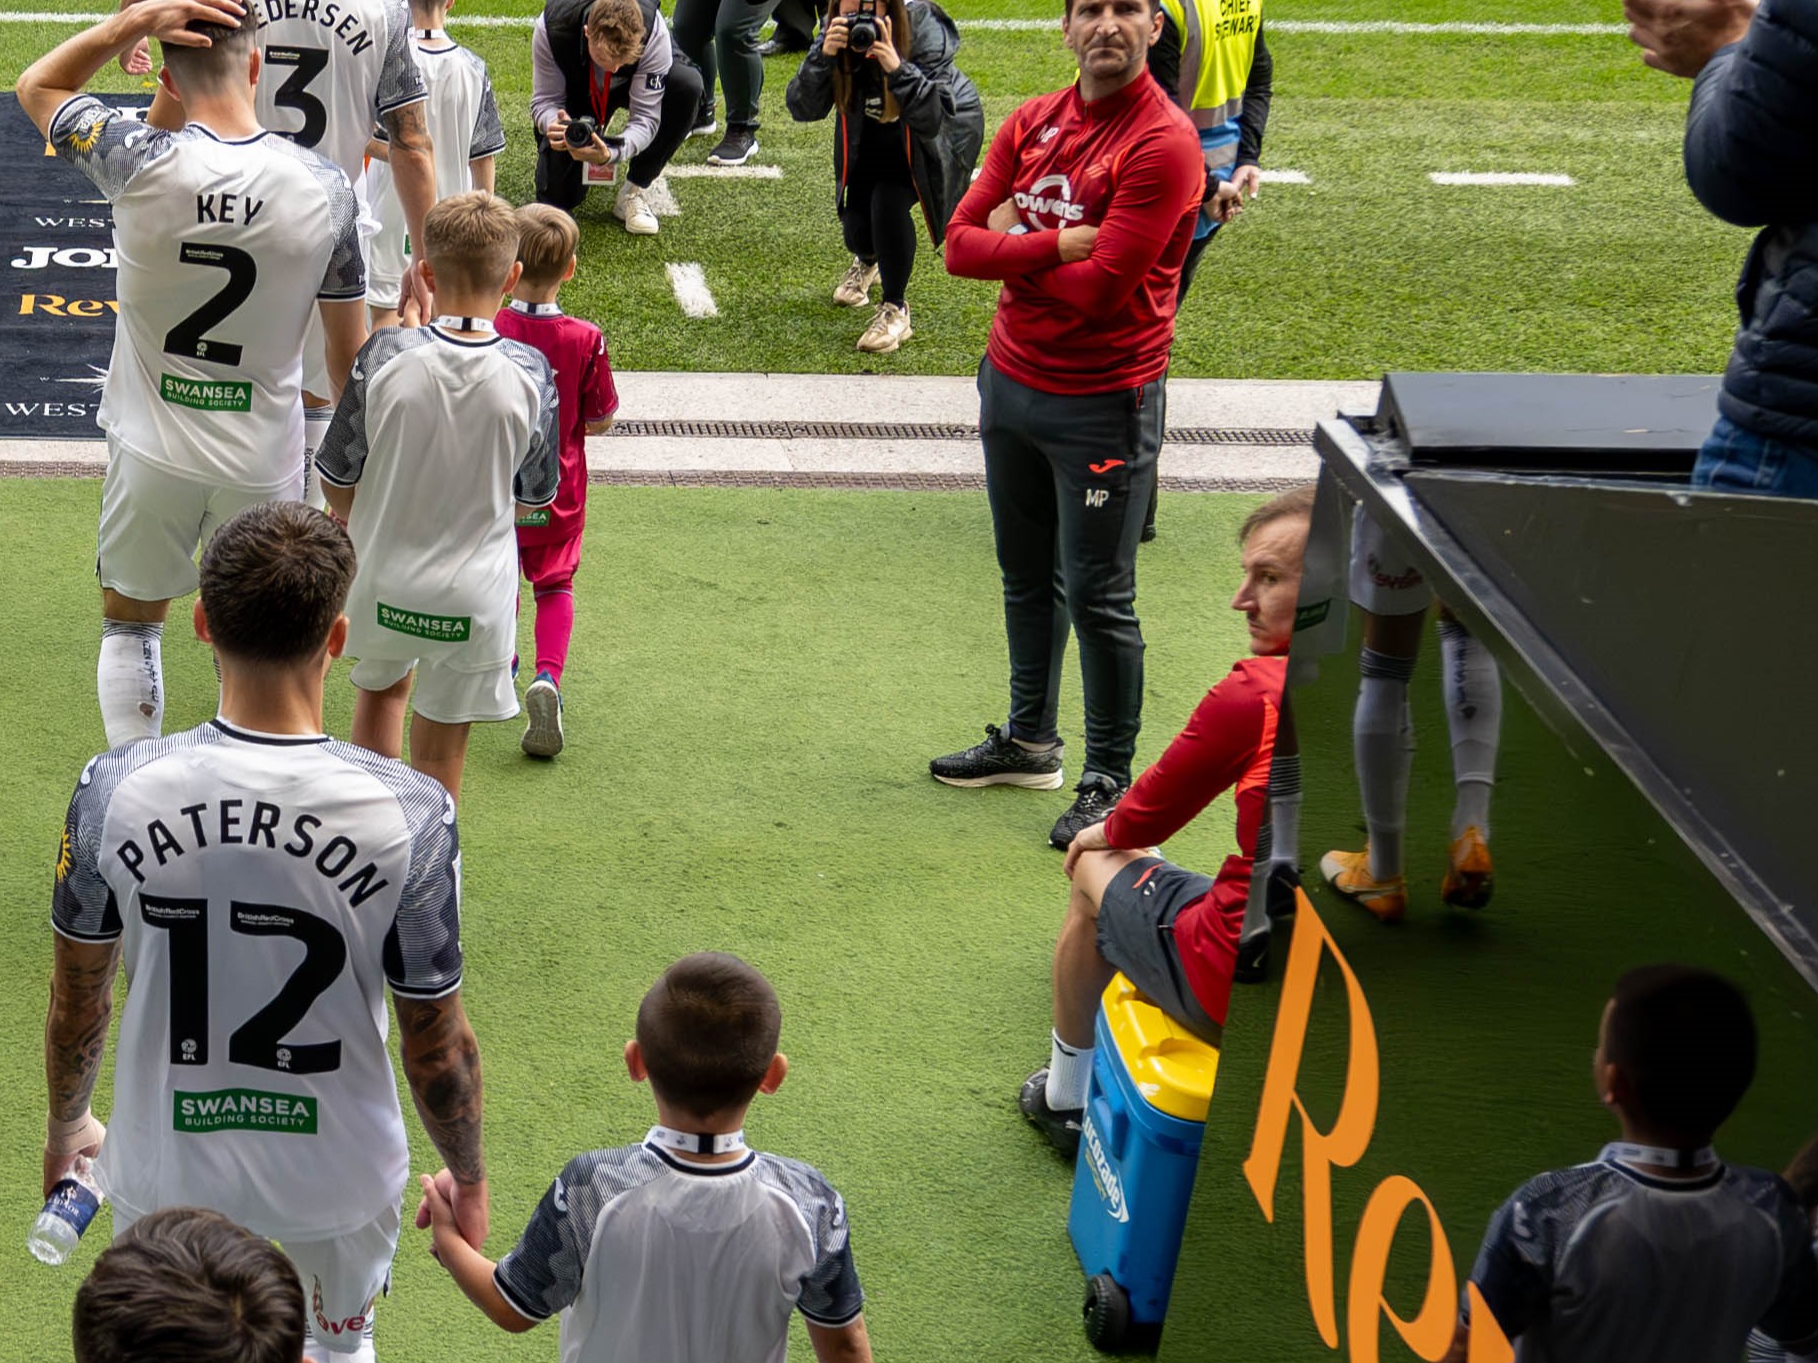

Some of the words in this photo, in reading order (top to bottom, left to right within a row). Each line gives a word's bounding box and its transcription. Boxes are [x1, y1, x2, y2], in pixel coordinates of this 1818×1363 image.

[264, 44, 330, 142] 3
[196, 193, 264, 226] KEY
[163, 241, 257, 367] 2
[164, 378, 248, 400] SWANSEA
[166, 391, 205, 406] BUILDING
[207, 399, 244, 408] SOCIETY
[1085, 488, 1111, 507] MP
[381, 607, 465, 632] SWANSEA
[115, 799, 389, 909] PATERSON
[139, 892, 347, 1075] 12
[276, 1059, 292, 1070] EFL
[180, 1097, 311, 1119] SWANSEA
[184, 1115, 245, 1126] BUILDING
[249, 1115, 306, 1128] SOCIETY
